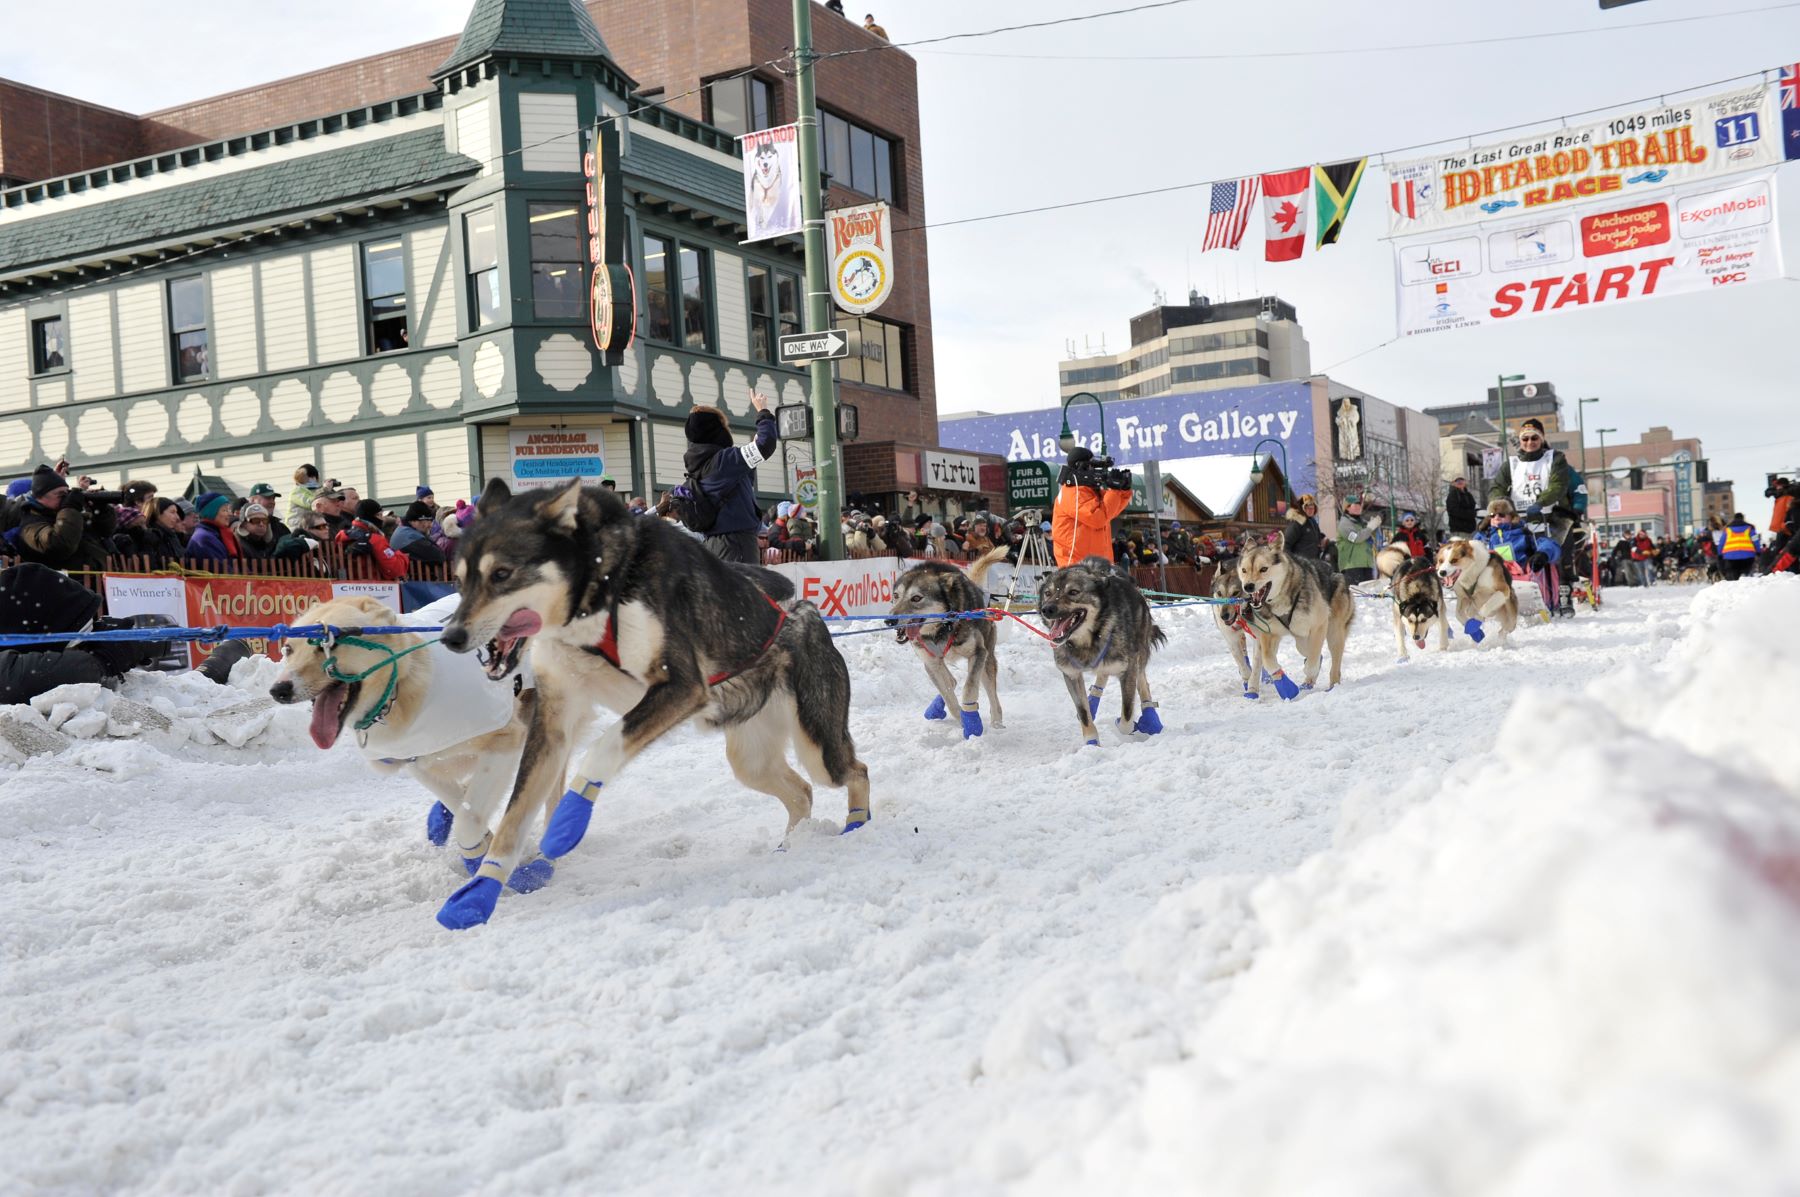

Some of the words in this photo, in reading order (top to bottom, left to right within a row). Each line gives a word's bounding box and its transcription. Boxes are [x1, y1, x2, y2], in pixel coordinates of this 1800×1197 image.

[1708, 90, 1764, 110] ANCHORAGE
[1716, 107, 1728, 115] TO
[1731, 101, 1759, 112] NOME
[1608, 115, 1646, 136] 1049
[1652, 108, 1692, 128] miles
[743, 125, 796, 153] IDITAROD
[1473, 150, 1502, 165] Last
[1510, 142, 1547, 158] Great
[1442, 145, 1590, 211] IDITAROD
[1593, 124, 1708, 171] TRAIL
[1523, 173, 1622, 208] RACE
[1680, 195, 1767, 223] ExxonMobil
[1592, 208, 1657, 230] Anchorage
[832, 208, 884, 261] RONDY
[1589, 227, 1628, 244] Chrysler
[1630, 222, 1662, 236] Dodge
[1432, 260, 1460, 275] GCI
[1700, 256, 1722, 266] Fred
[1725, 251, 1754, 262] Meyer
[1490, 256, 1675, 318] START
[1414, 324, 1451, 335] HORIZON
[1455, 320, 1481, 329] LINES
[788, 343, 809, 354] ONE
[810, 340, 828, 352] WAY
[527, 433, 587, 445] ANCHORAGE
[1007, 428, 1104, 462] Alaka
[1117, 415, 1168, 450] Fur
[1178, 410, 1298, 444] Gallery
[514, 445, 535, 456] FUR
[536, 444, 600, 455] RENDEZVOUS
[521, 468, 534, 476] Dog
[562, 466, 572, 474] Hall
[931, 460, 976, 486] virtu
[1016, 468, 1035, 478] FUR
[1036, 466, 1043, 476] &
[1011, 476, 1049, 488] LEATHER
[1522, 482, 1542, 498] 46
[1012, 486, 1050, 499] OUTLET
[110, 586, 128, 597] The
[129, 588, 172, 598] Winner's
